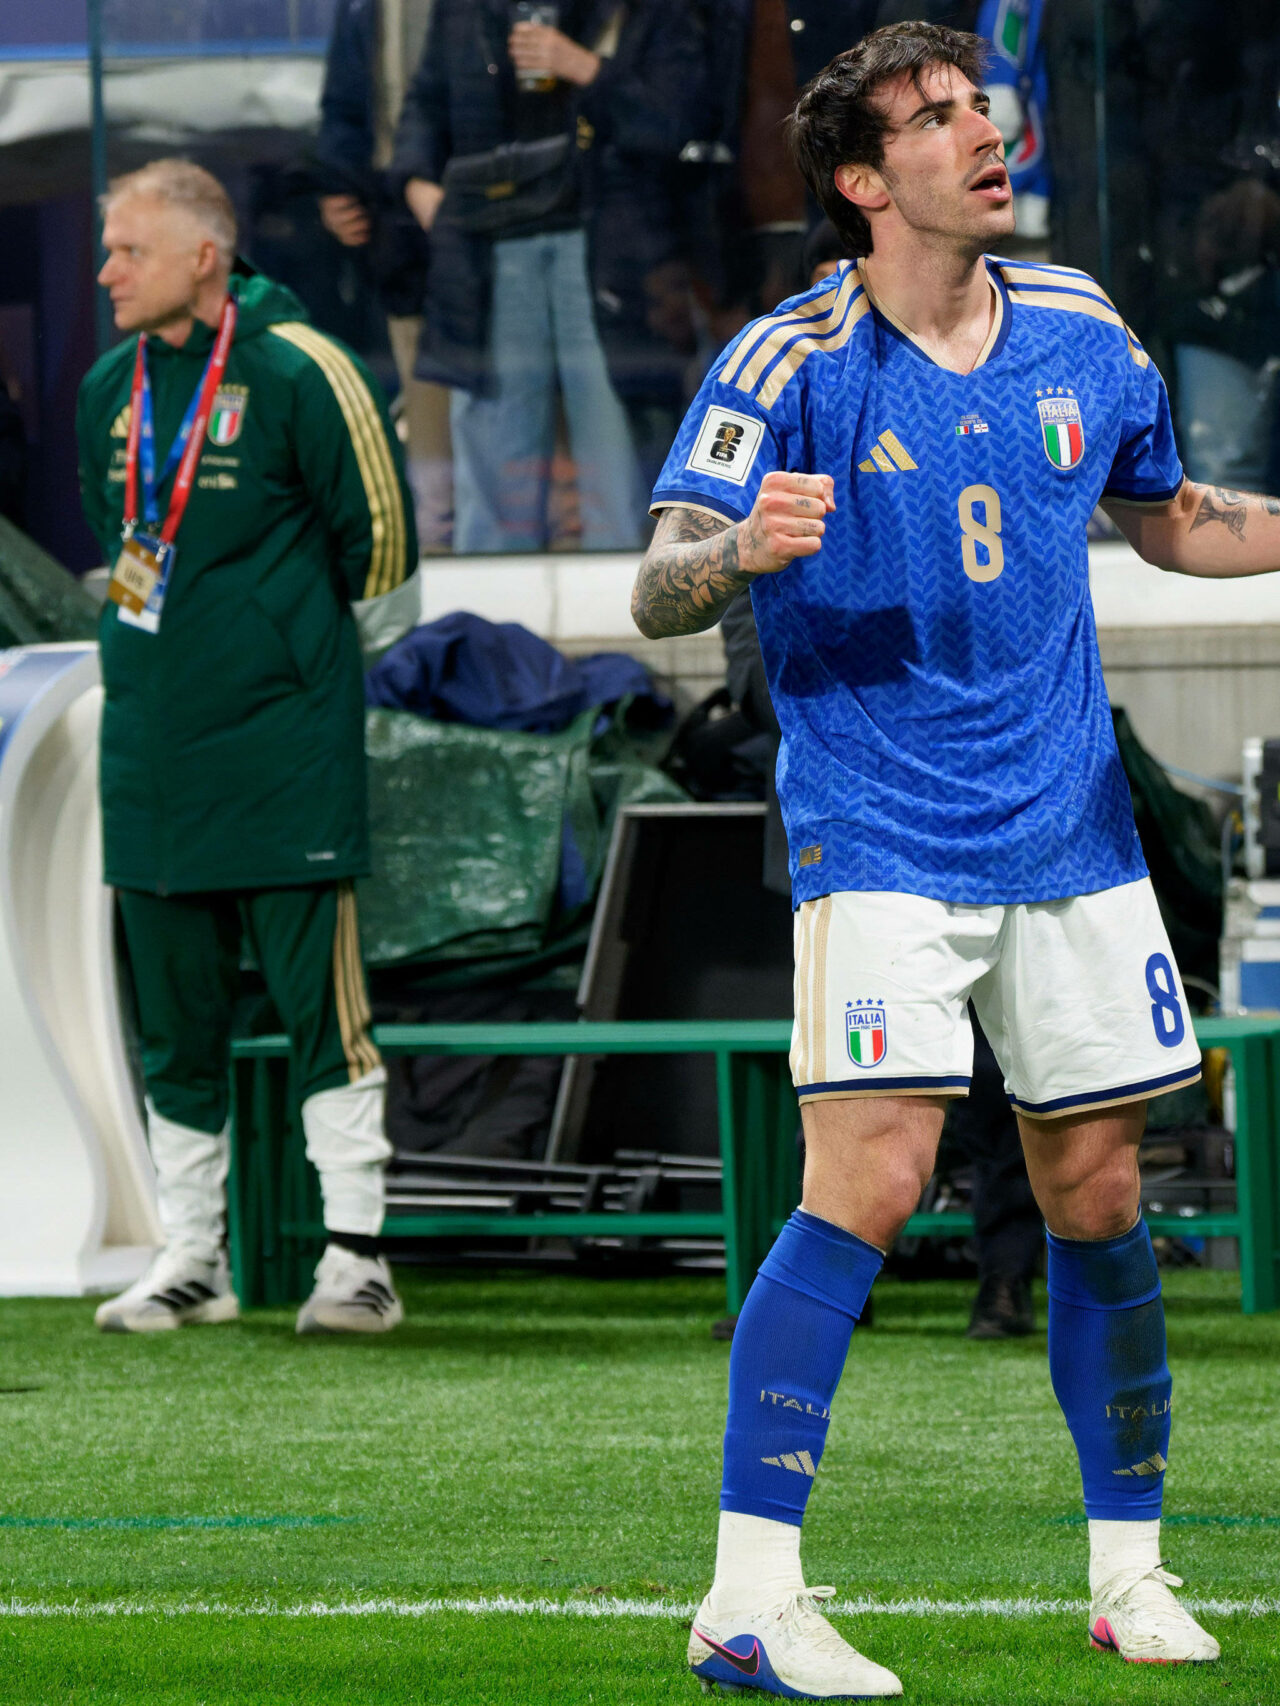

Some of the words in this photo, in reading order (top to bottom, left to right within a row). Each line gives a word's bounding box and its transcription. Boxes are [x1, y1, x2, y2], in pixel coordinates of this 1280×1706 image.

[1040, 402, 1078, 418] ITALIA
[957, 483, 1005, 583] 8
[848, 1012, 883, 1026] ITALIA
[1144, 952, 1186, 1048] 8
